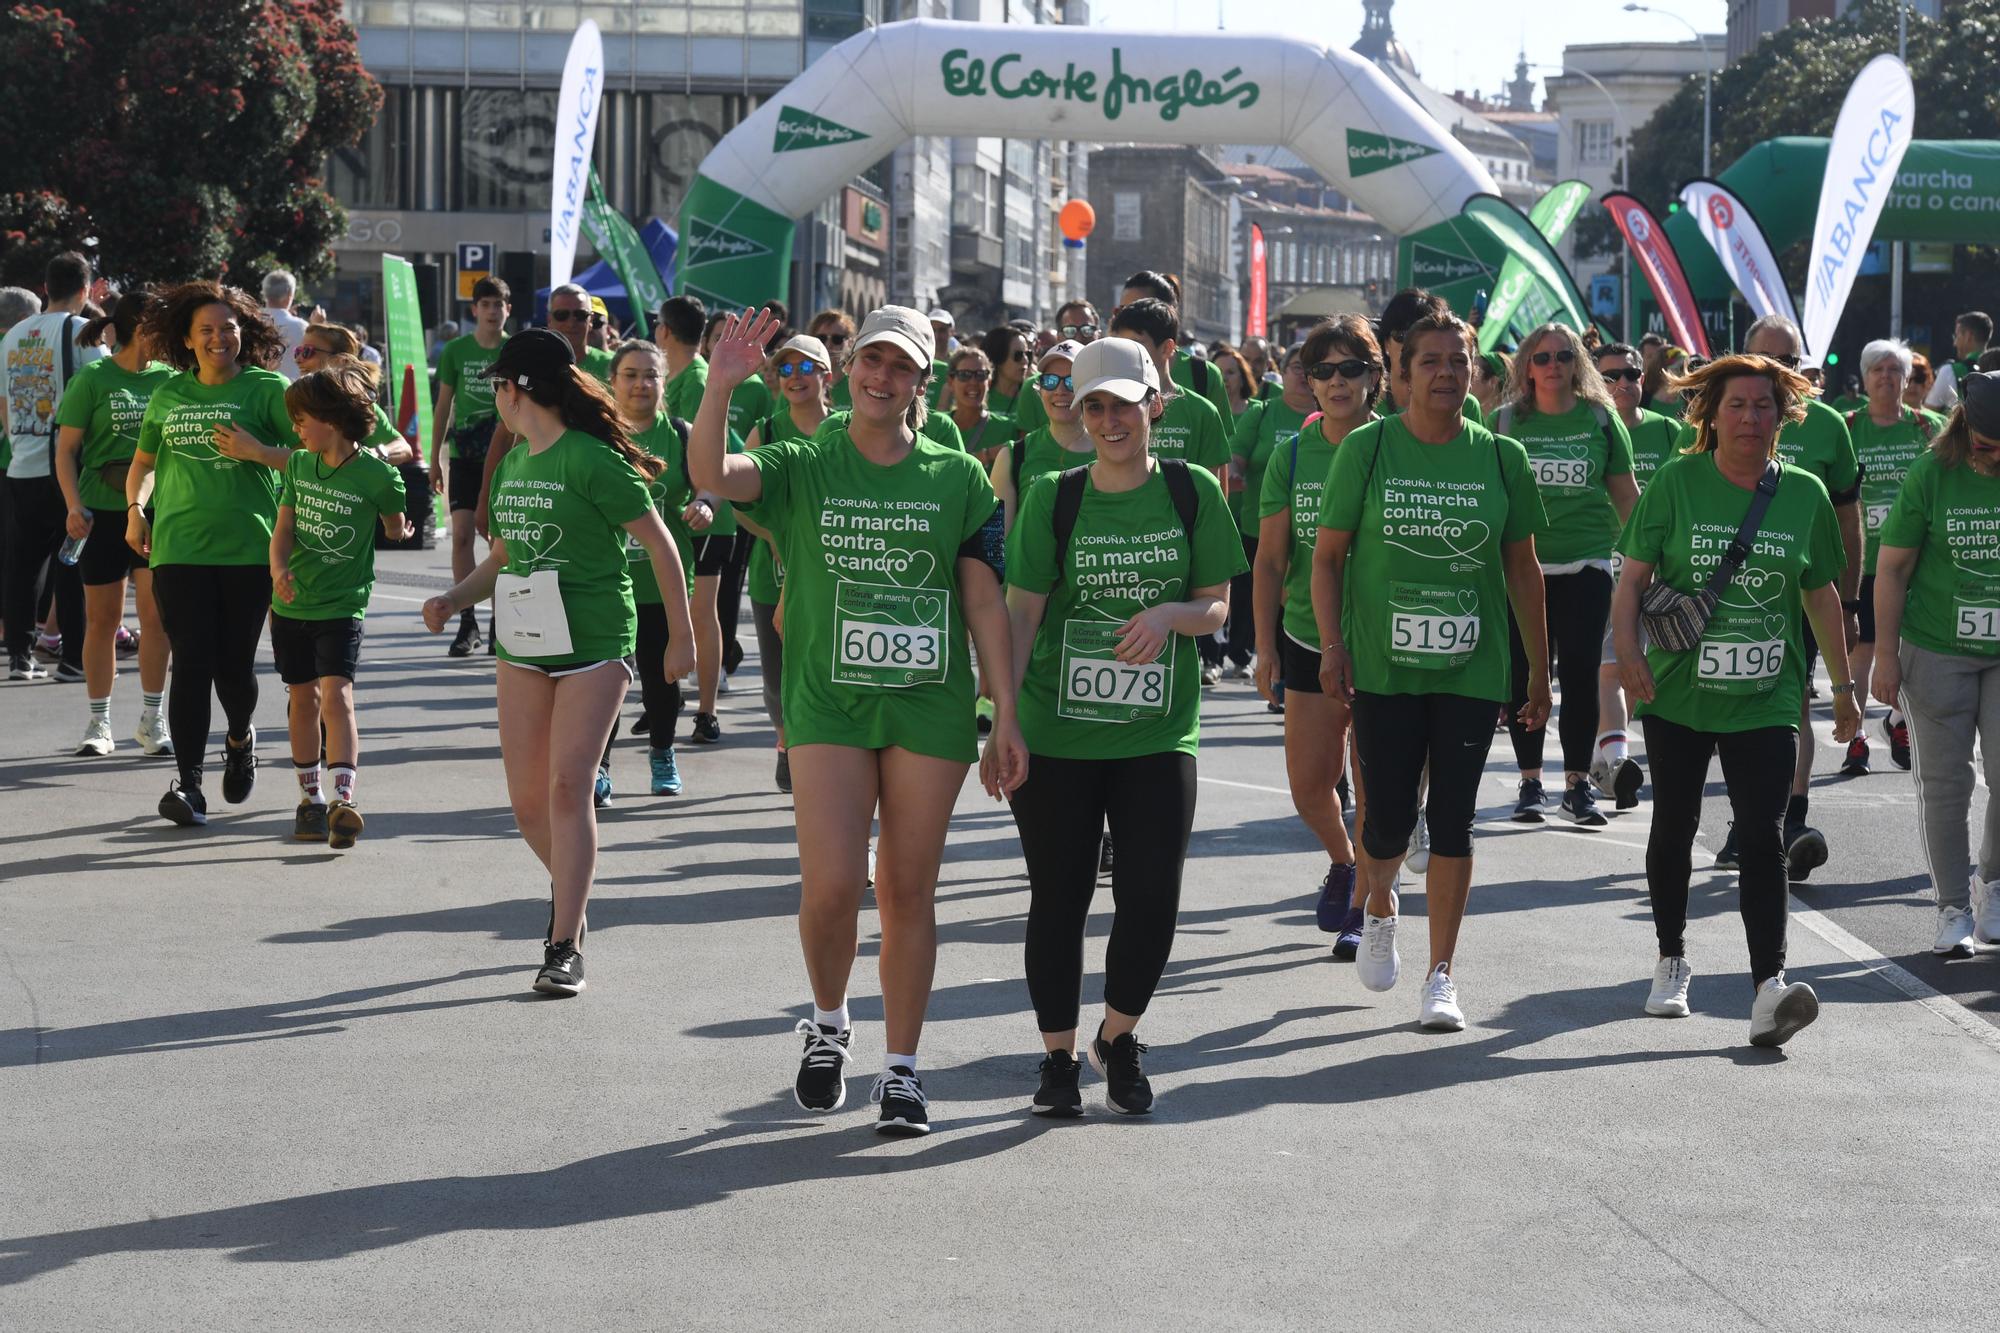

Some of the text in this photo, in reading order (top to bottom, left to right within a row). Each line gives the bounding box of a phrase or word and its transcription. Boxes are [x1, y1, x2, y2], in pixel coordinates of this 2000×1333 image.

[941, 47, 1259, 121] El Corte Inglés
[1887, 190, 2000, 211] tra o can
[465, 247, 484, 268] P
[8, 348, 53, 367] PIZZA
[111, 400, 148, 409] En mar
[111, 411, 144, 420] contr
[165, 410, 231, 423] En marcha
[163, 421, 203, 435] contra
[166, 438, 172, 446] o
[1149, 437, 1185, 448] archa
[1858, 451, 1916, 463] En marcha
[1634, 461, 1656, 471] cha
[1865, 462, 1895, 471] ontra
[296, 479, 322, 492] CORUÑA
[333, 489, 363, 503] EDICIÓN
[533, 480, 564, 491] EDICIÓN
[1302, 482, 1325, 490] CORU
[1385, 477, 1485, 491] A CORUÑA IX EDICIÓN
[303, 494, 352, 515] marcha
[505, 493, 553, 509] marcha
[824, 497, 940, 512] A CORUÑA IX EDICIÓN
[1295, 494, 1312, 507] En
[1384, 489, 1479, 507] En marcha
[295, 505, 321, 522] ontra
[495, 509, 526, 524] ontra
[1295, 510, 1319, 522] con
[1384, 506, 1442, 521] contra
[1953, 507, 1990, 515] CORUÑA
[821, 510, 930, 533] En marcha
[1946, 519, 2000, 531] En mar
[1081, 535, 1126, 545] CORUÑA
[1131, 536, 1142, 544] IX
[1143, 527, 1183, 544] EDICIÓN
[1297, 528, 1304, 537] o
[1384, 523, 1462, 538] o cancro
[1757, 530, 1795, 542] EDICIÓN
[821, 533, 886, 551] contra
[1691, 535, 1786, 557] En mcha
[1948, 532, 1998, 546] contra
[1076, 546, 1178, 568] En marcha
[1952, 548, 2000, 560] o canc
[825, 553, 908, 572] o cancro
[1690, 554, 1747, 570] cona
[1077, 569, 1139, 586] contra
[1692, 572, 1702, 583] o
[884, 594, 911, 603] marcha
[1081, 586, 1159, 601] o cancro
[1738, 616, 1762, 624] marcha
[1959, 610, 1997, 638] 51
[1394, 617, 1477, 650] 5194
[845, 629, 936, 665] 6083
[1700, 644, 1782, 676] 5196
[1071, 666, 1162, 703] 6078
[1083, 707, 1098, 715] Maio
